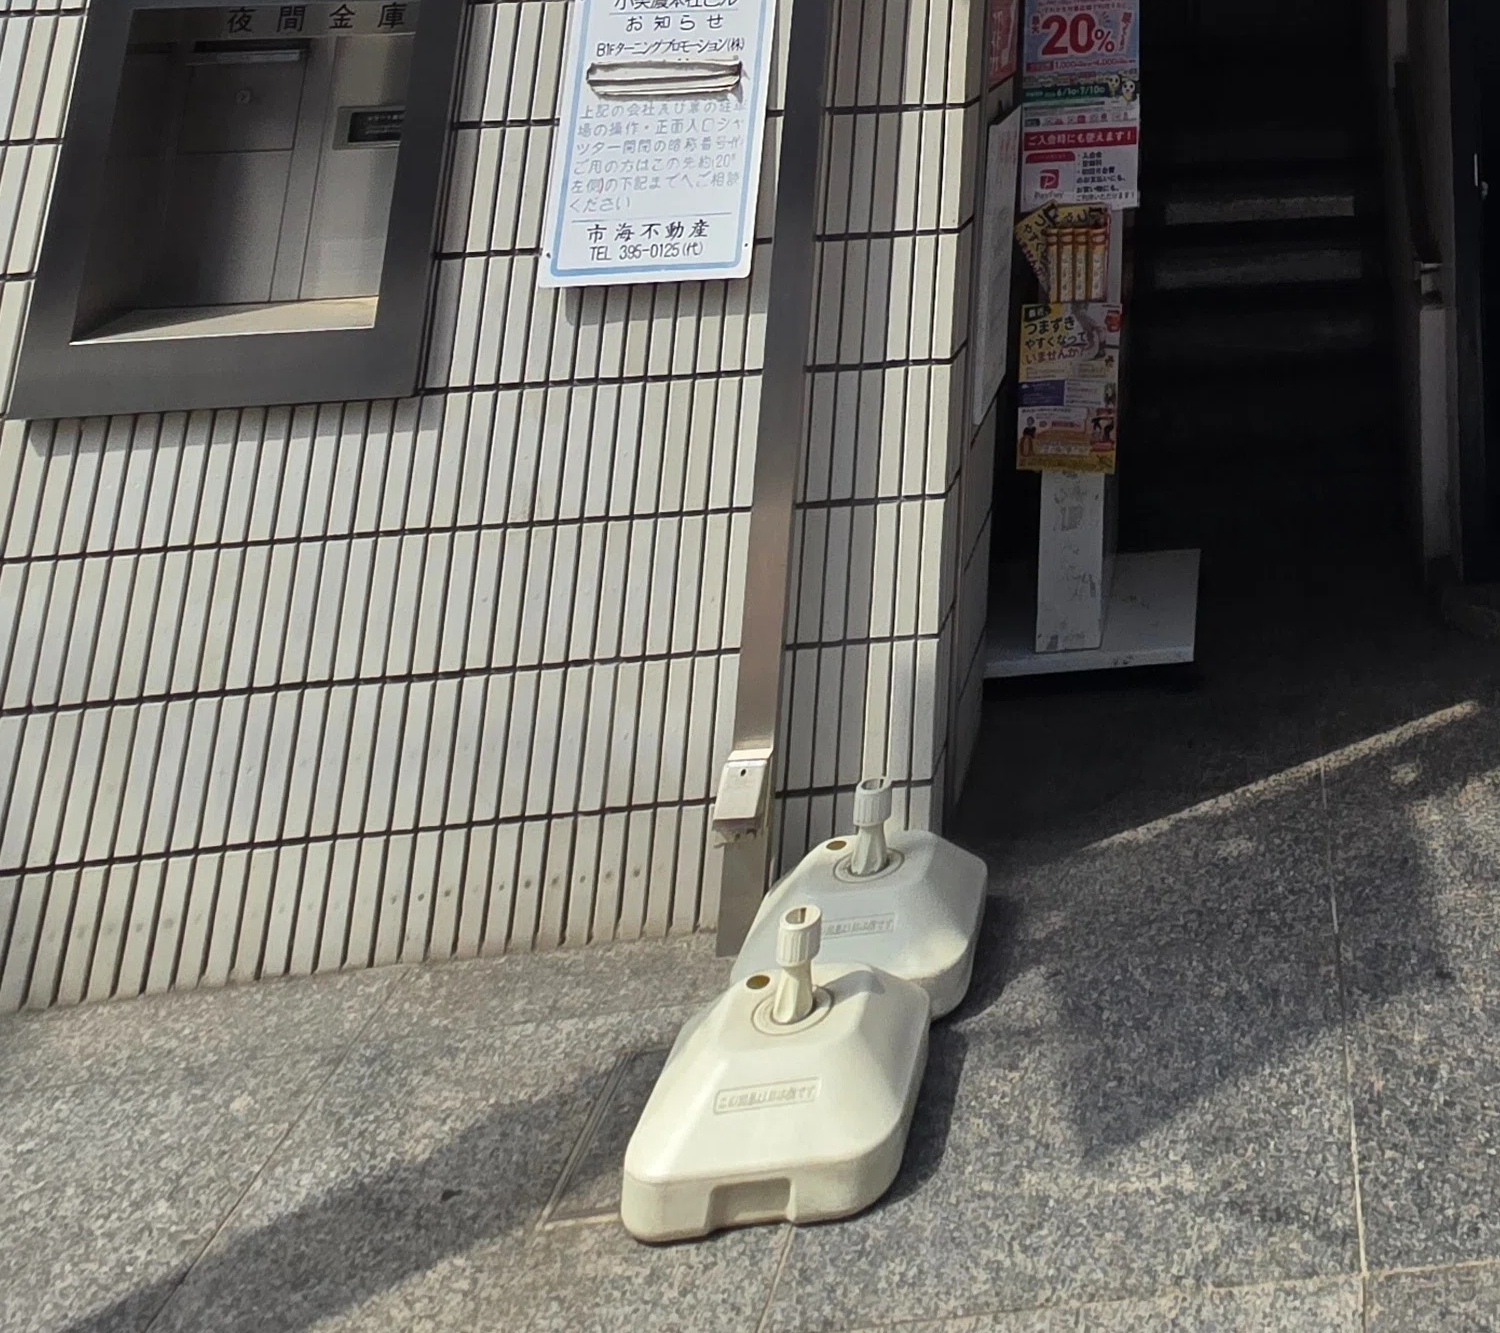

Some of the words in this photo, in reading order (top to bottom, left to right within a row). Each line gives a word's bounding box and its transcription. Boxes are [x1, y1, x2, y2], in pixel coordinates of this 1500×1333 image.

[227, 2, 407, 33] 夜間金庫
[626, 14, 724, 32] お知らせ
[1042, 13, 1115, 56] 20%
[587, 218, 710, 243] 市海不動産
[589, 246, 612, 261] TEL
[1024, 316, 1075, 335] つまずき
